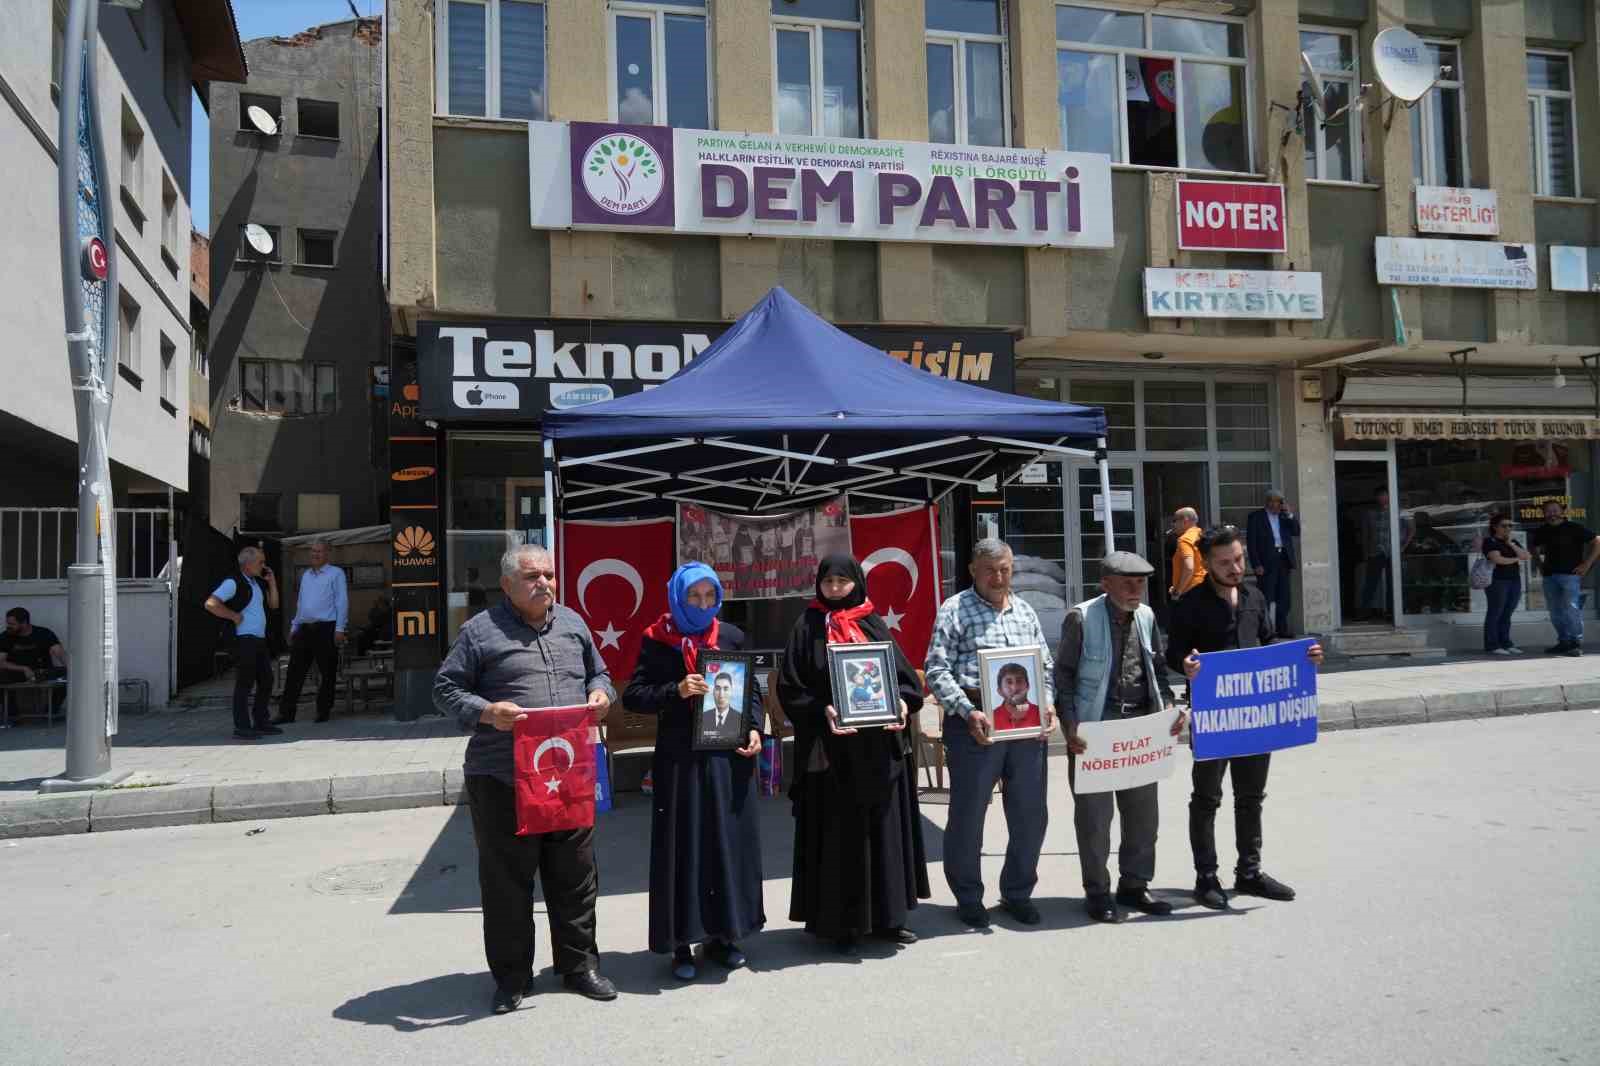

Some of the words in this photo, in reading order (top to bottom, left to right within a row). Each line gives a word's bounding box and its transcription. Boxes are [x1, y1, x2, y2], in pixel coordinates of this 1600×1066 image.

[738, 140, 772, 151] GELAN
[698, 152, 755, 163] HALKLARIN
[797, 158, 809, 166] VE
[931, 164, 964, 178] MUŞ
[600, 196, 620, 210] DEM
[701, 164, 855, 224] DEM
[878, 166, 1081, 233] PARTİ
[1185, 201, 1278, 231] NOTER
[1151, 289, 1318, 313] KIRTASİYE
[393, 557, 436, 567] HUAWEI
[1215, 671, 1254, 698] ARTIK
[1256, 665, 1290, 694] YETER
[1193, 702, 1277, 734] YAKAMIZDAN
[1112, 736, 1152, 753] EVLAT
[1081, 745, 1173, 771] NÖBETİNDEYİZ
